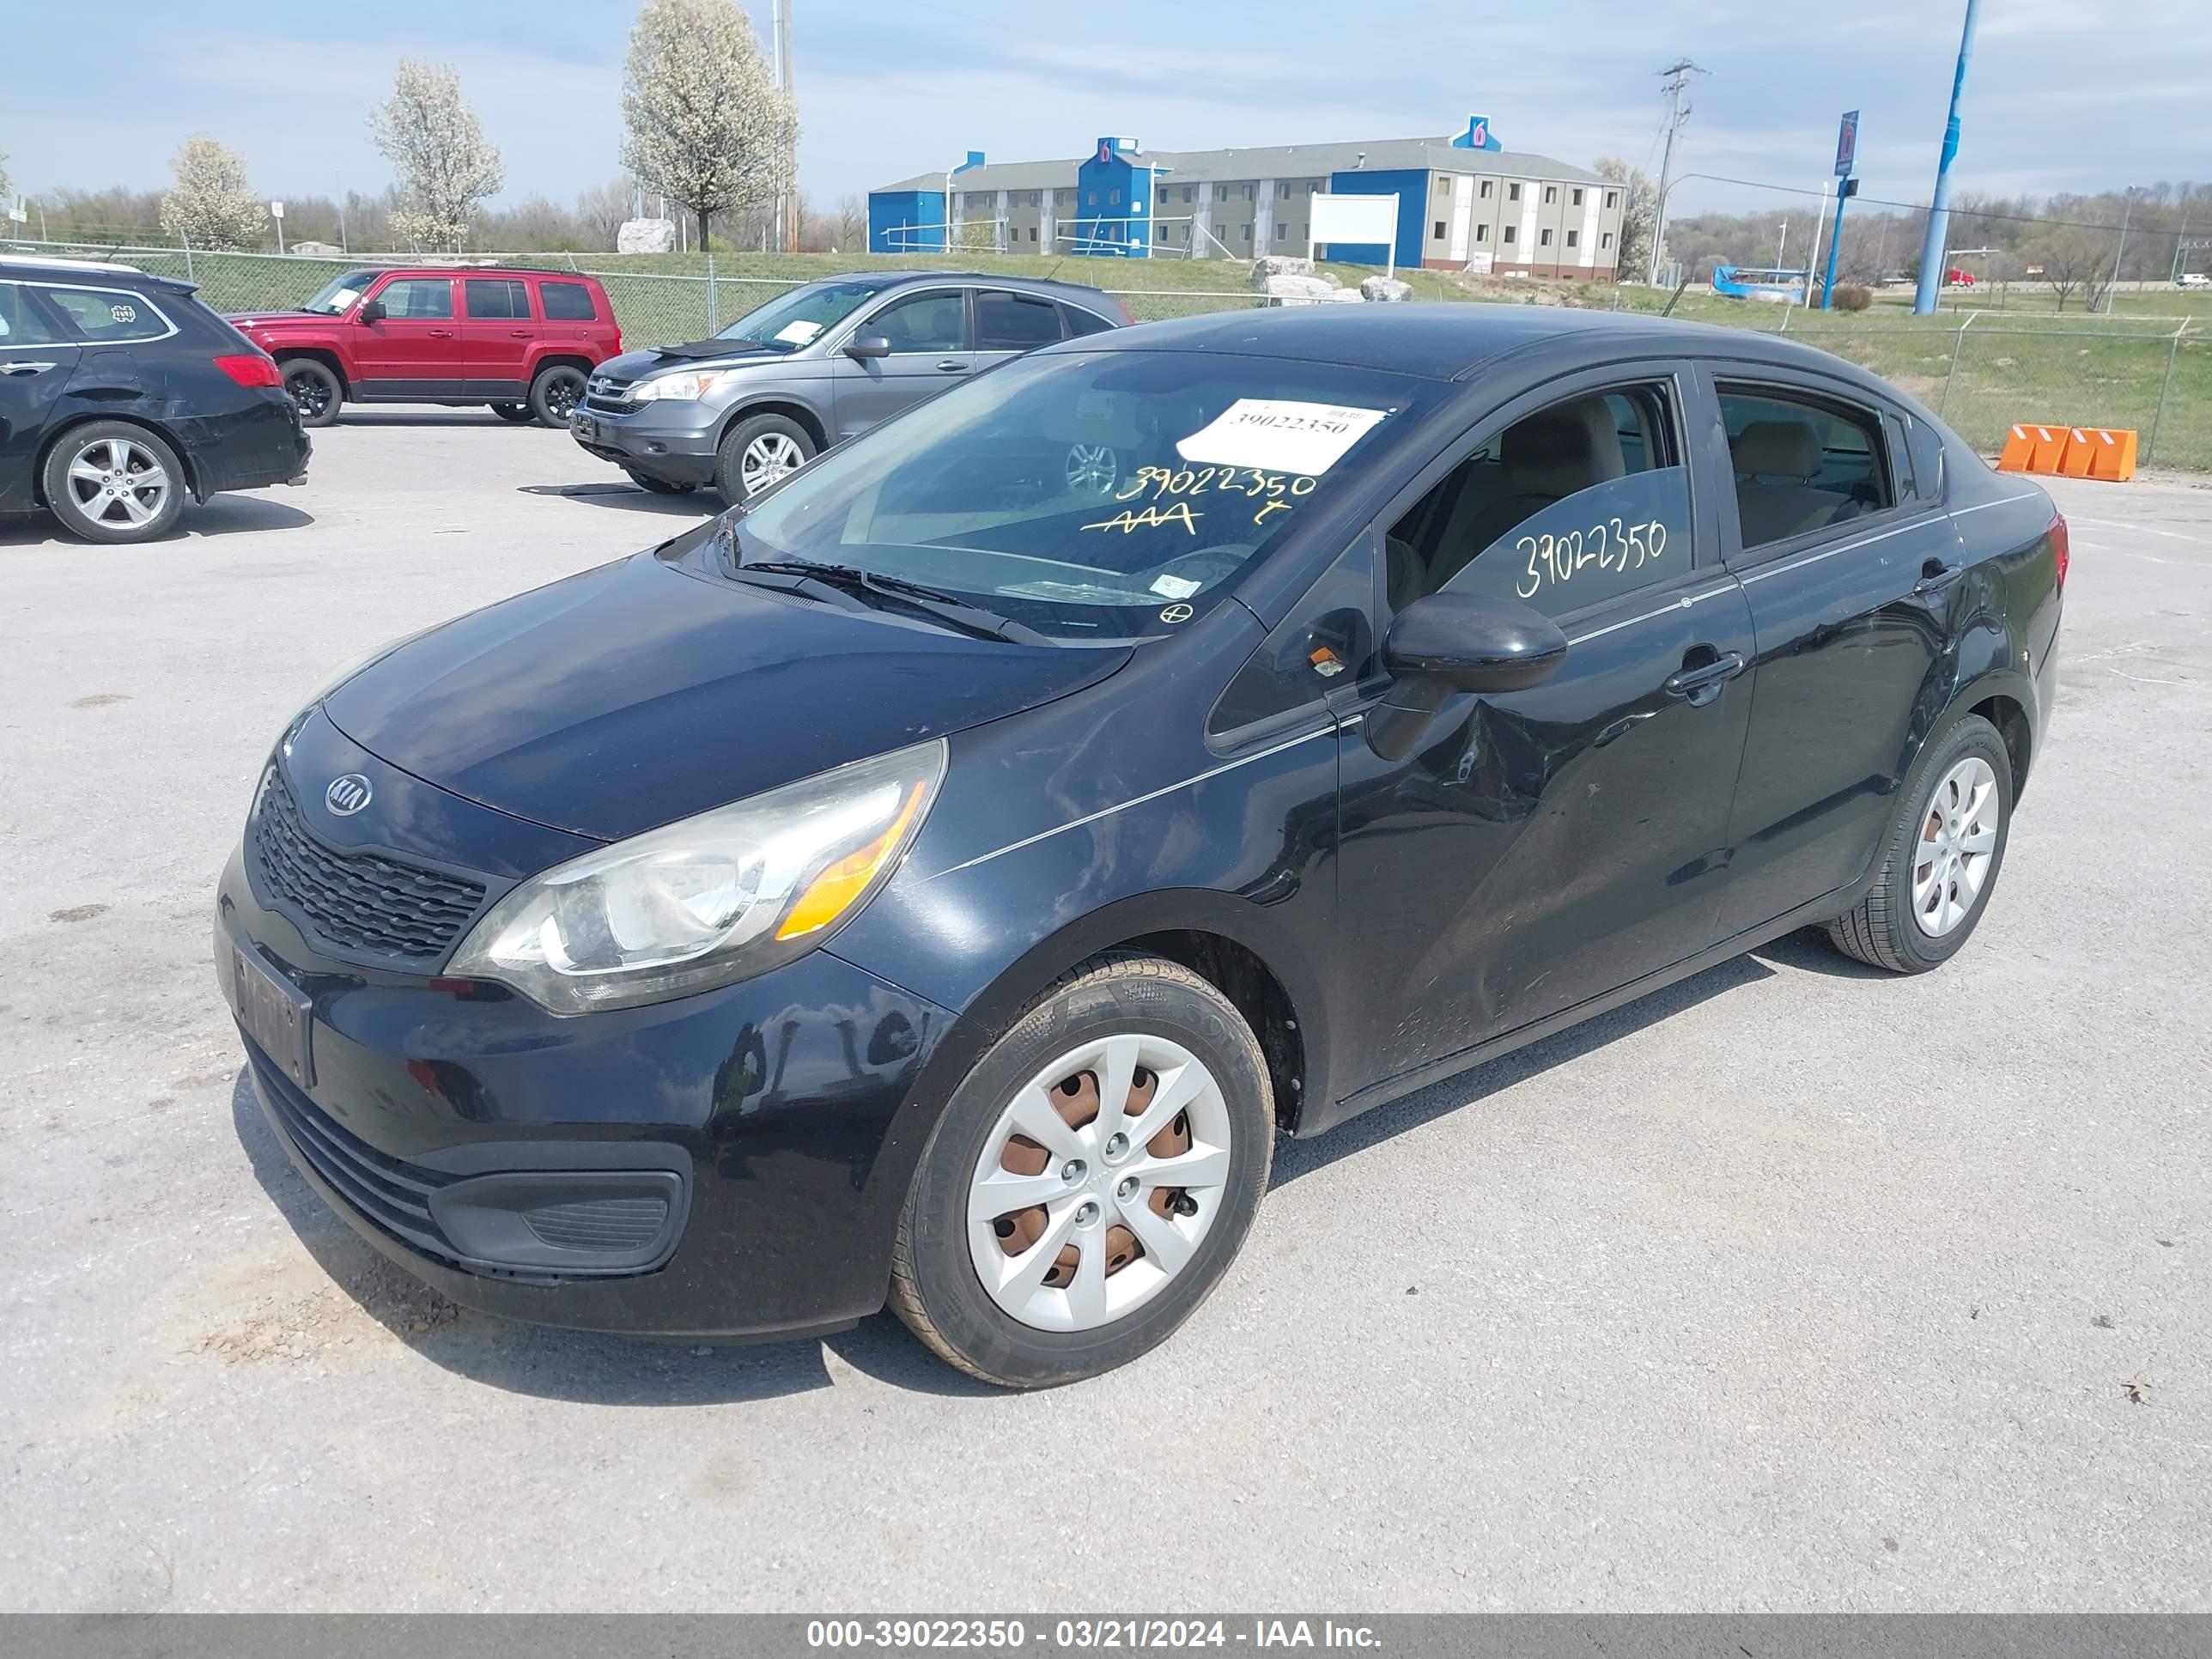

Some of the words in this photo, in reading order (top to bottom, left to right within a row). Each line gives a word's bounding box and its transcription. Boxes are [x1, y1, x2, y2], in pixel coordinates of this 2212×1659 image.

[1474, 121, 1486, 147] 6
[1230, 412, 1351, 434] 39022350
[1116, 466, 1316, 501] 39022350
[1516, 517, 1667, 599] 39022350
[329, 779, 364, 810] KIA
